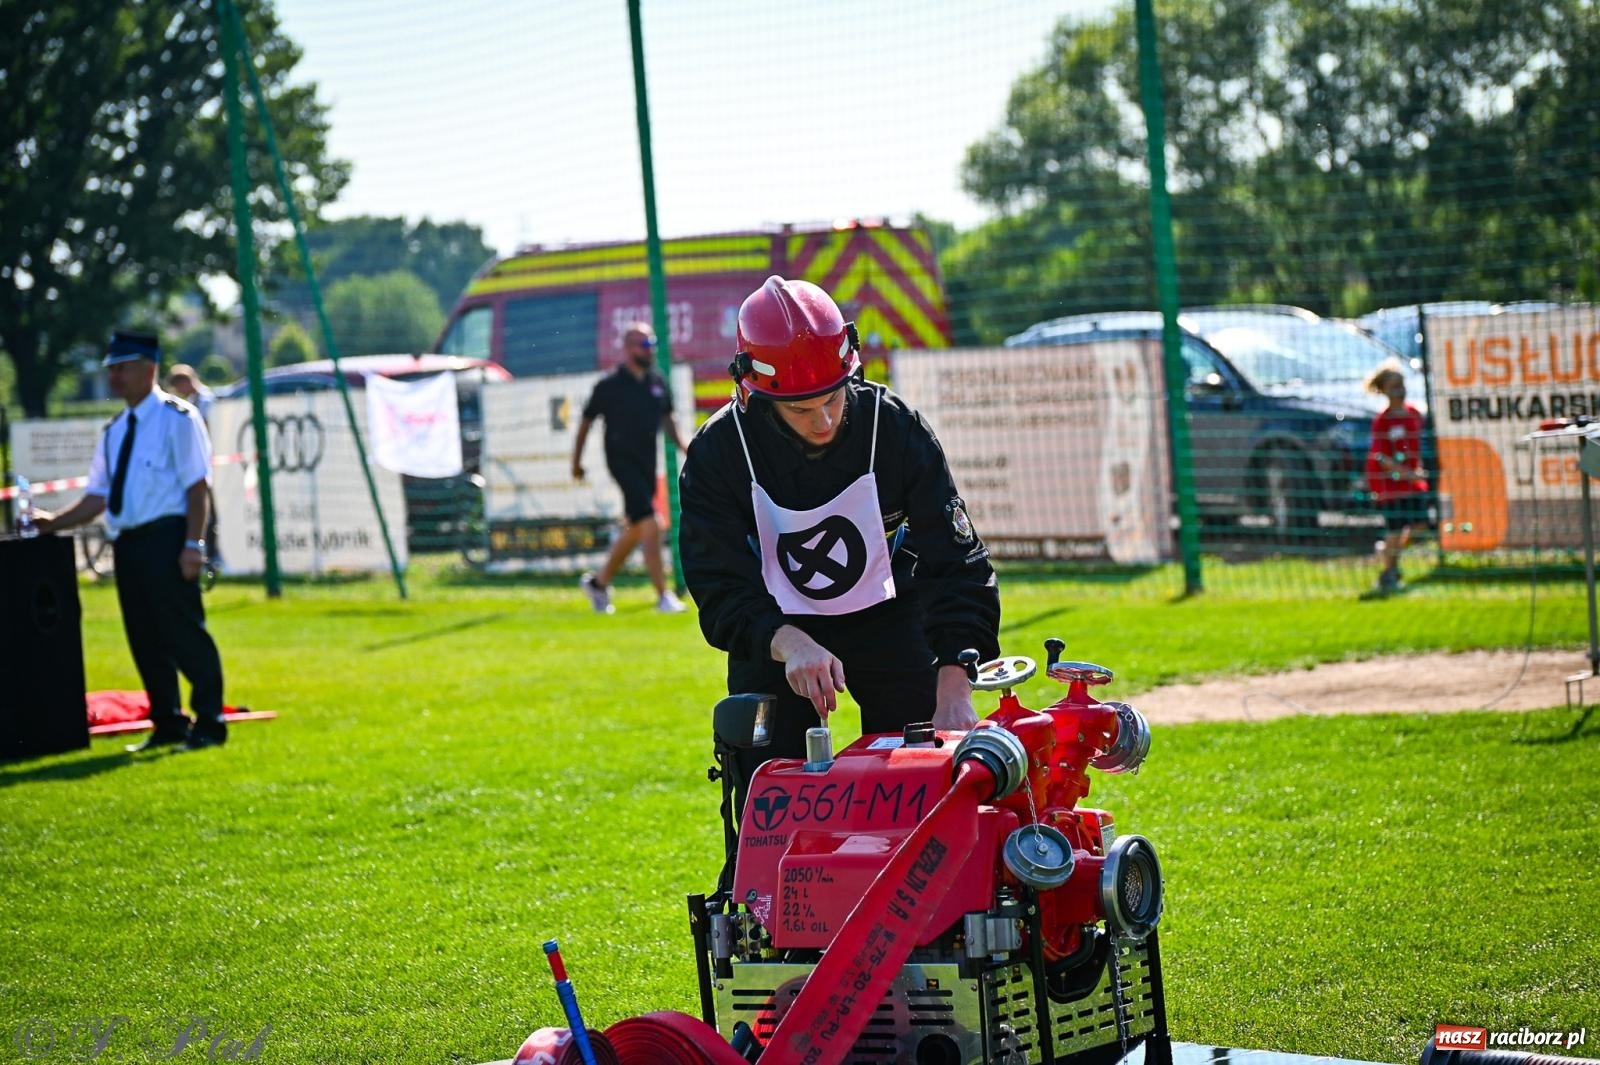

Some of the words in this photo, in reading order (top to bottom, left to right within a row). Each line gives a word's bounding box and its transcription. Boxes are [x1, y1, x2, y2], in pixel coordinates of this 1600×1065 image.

[792, 782, 928, 824] 561-M1
[744, 834, 787, 847] TOHATSU
[784, 867, 813, 883] 2050
[784, 886, 798, 900] 24
[783, 902, 800, 916] 22
